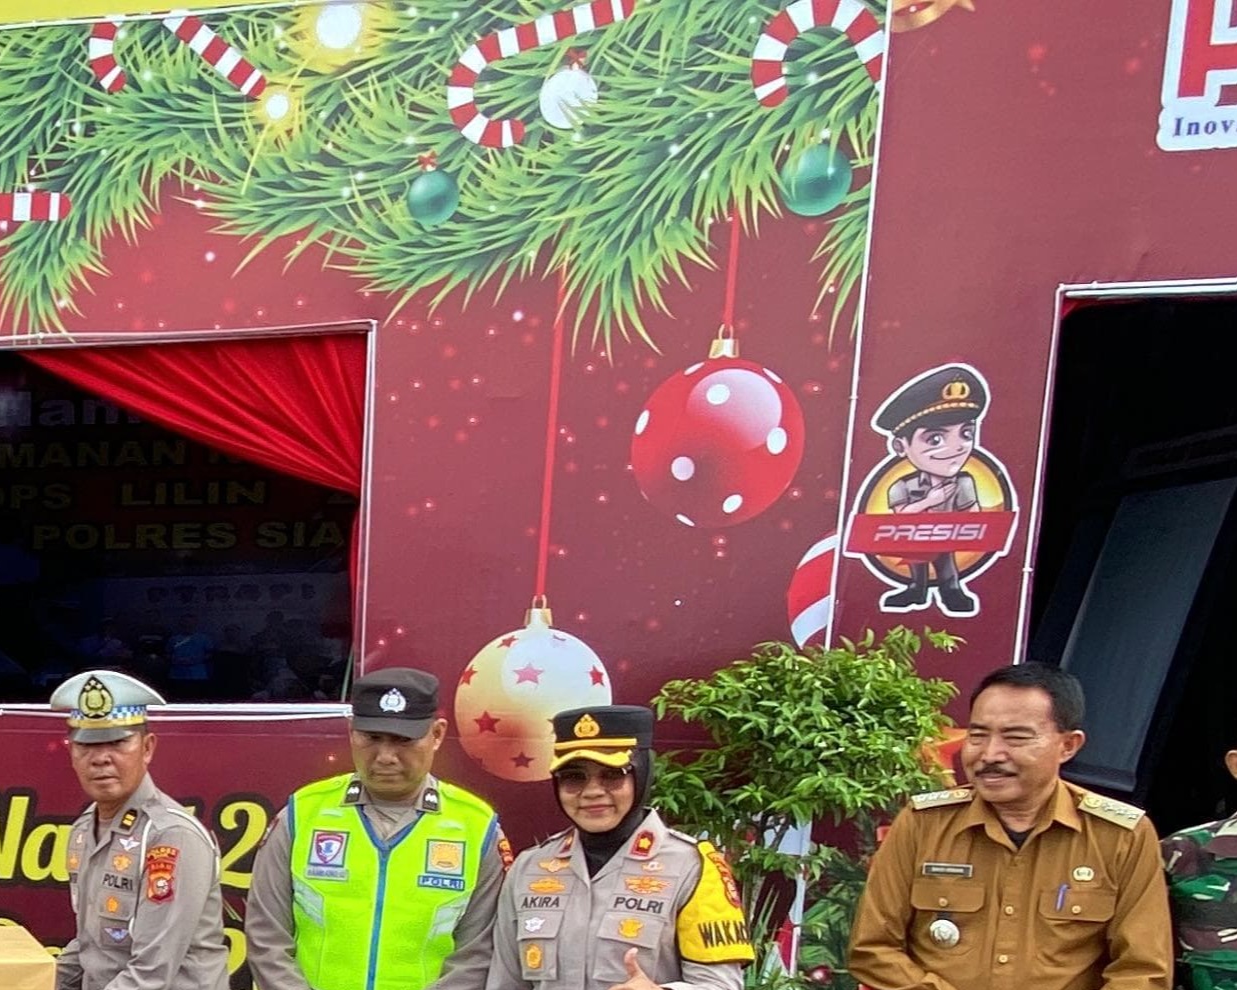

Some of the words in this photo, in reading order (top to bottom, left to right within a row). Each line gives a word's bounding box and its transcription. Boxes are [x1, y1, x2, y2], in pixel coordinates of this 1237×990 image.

[1172, 117, 1237, 137] Inov
[119, 479, 268, 507] LILIN
[31, 522, 237, 550] POLRES
[255, 520, 345, 548] SIA
[873, 523, 988, 542] PRESISI
[103, 873, 134, 891] POLRI
[421, 876, 463, 889] POLRI
[520, 896, 560, 909] AKIRA
[613, 896, 665, 914] POLRI
